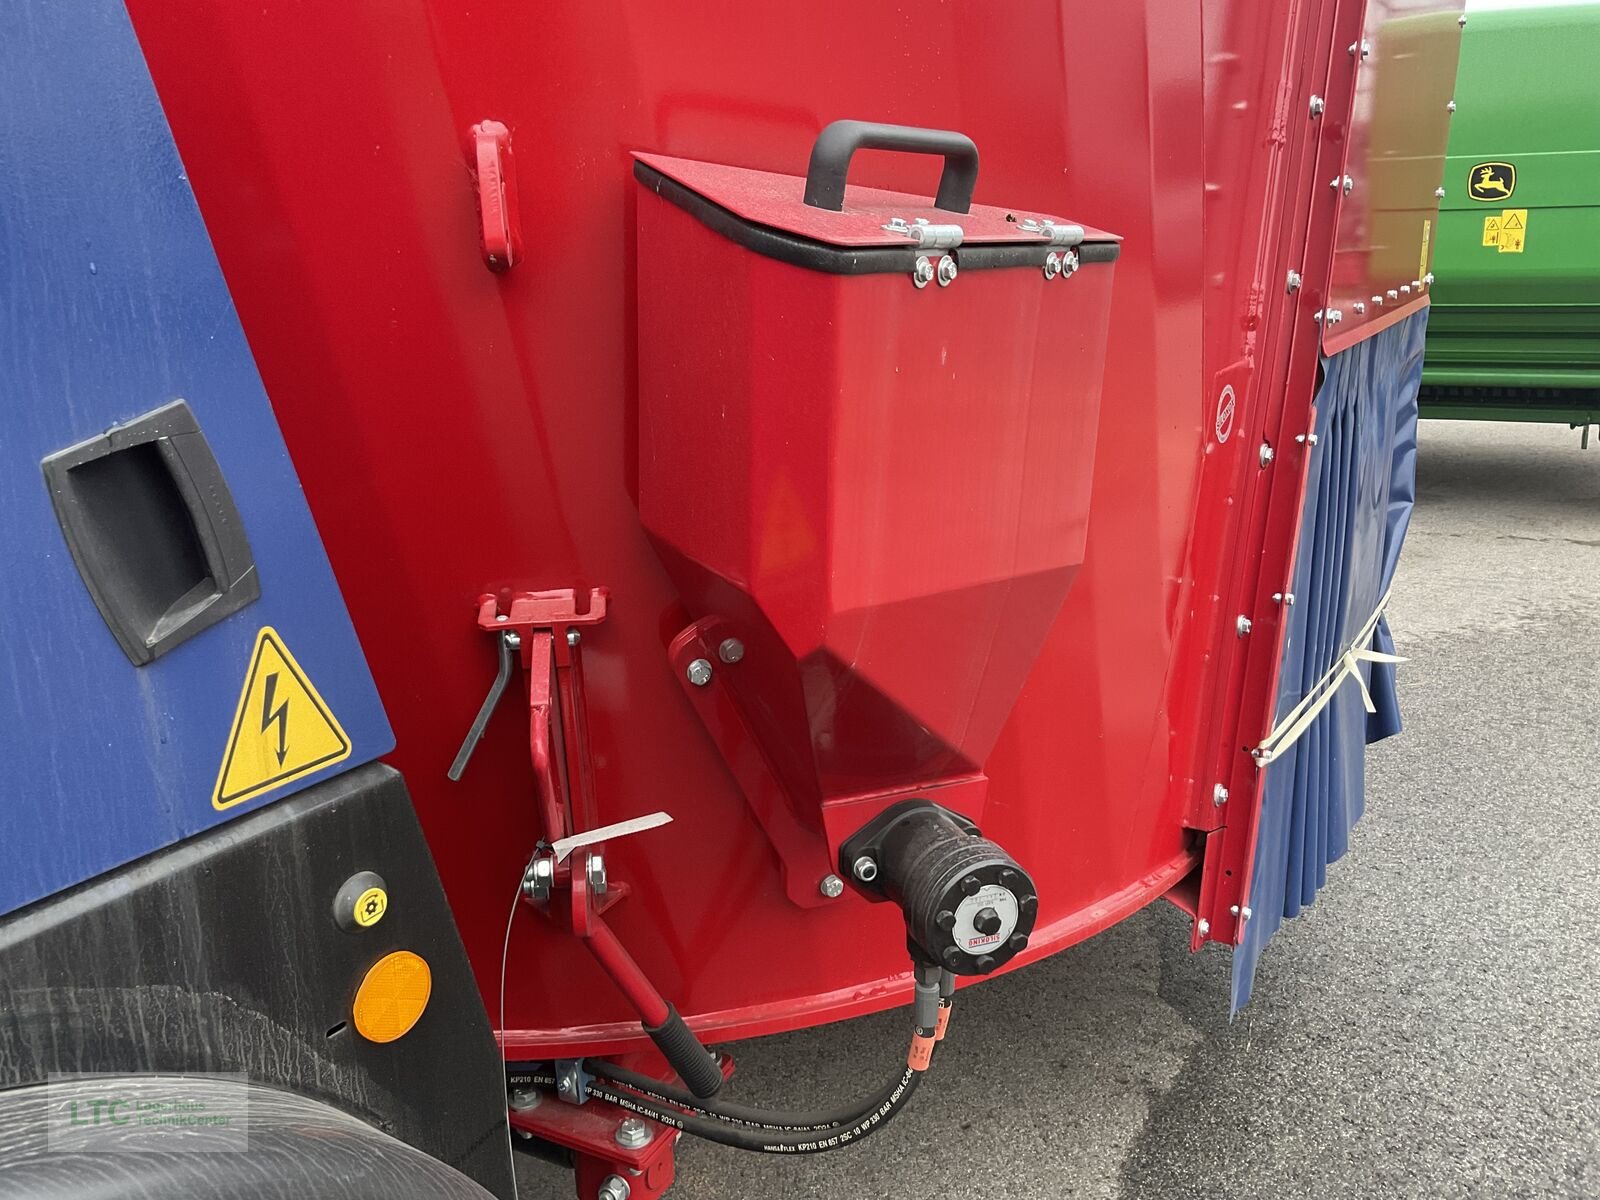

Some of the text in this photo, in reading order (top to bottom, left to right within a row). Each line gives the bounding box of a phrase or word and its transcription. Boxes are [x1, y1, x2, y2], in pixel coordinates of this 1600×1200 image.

[510, 1076, 531, 1084] KP210
[533, 1076, 544, 1084] EN
[593, 1089, 603, 1098] 330
[605, 1093, 618, 1103] BAR
[620, 1098, 637, 1111] MSHA
[798, 1143, 817, 1151] KP210
[818, 1140, 828, 1149] EN
[828, 1137, 839, 1147] 857
[840, 1131, 853, 1142] 2SC
[853, 1127, 861, 1136] 10
[860, 1120, 871, 1130] WP
[869, 1112, 881, 1125] 330
[879, 1101, 892, 1116] BAR
[890, 1084, 905, 1104] MSHA
